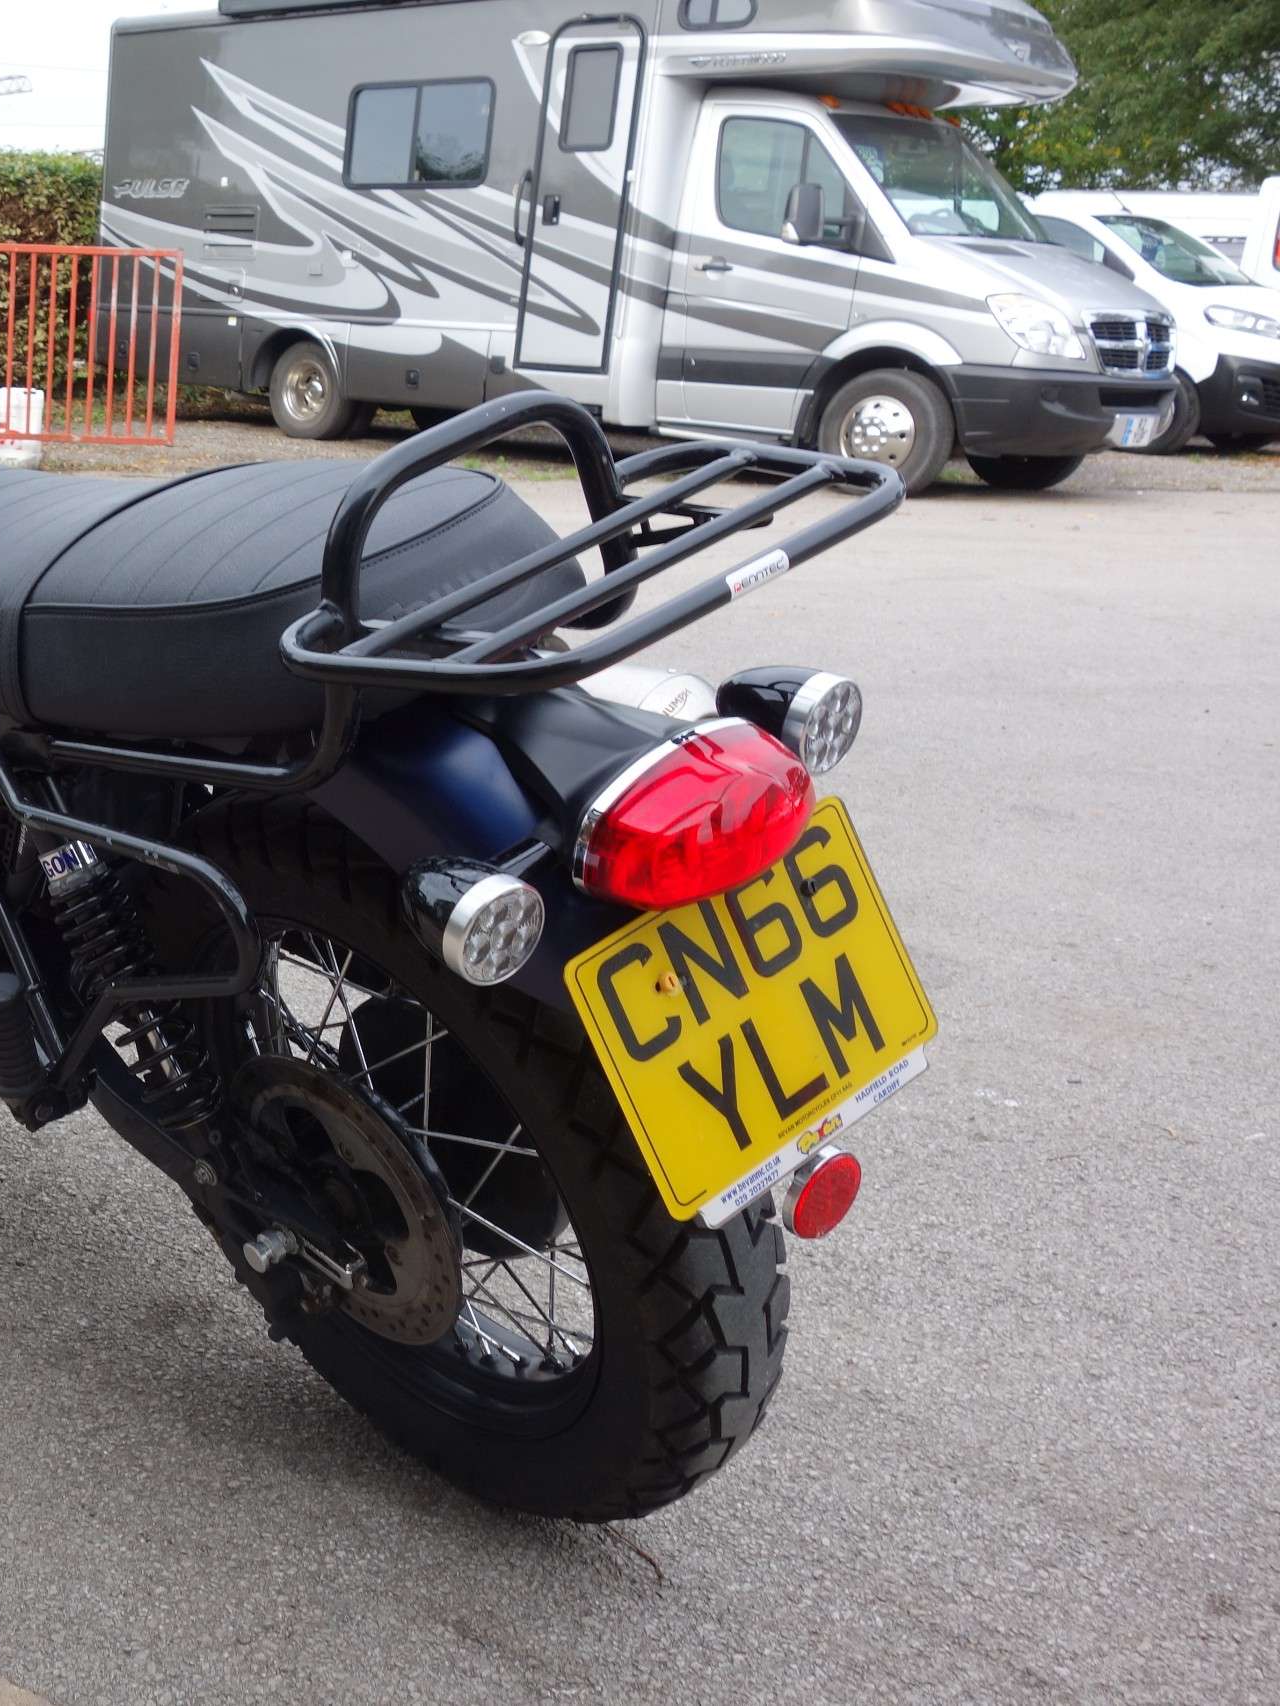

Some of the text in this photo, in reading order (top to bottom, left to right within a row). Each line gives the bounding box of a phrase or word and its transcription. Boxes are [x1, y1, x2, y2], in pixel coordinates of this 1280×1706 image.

[113, 179, 190, 199] PULSE
[596, 825, 859, 1062] CN66
[677, 952, 887, 1151] YLM
[855, 1059, 910, 1104] HADFIELD ROAD
[873, 1079, 901, 1104] CARDIFF
[721, 1155, 782, 1204] www.bevanmc.co.uk
[734, 1193, 748, 1207] 029
